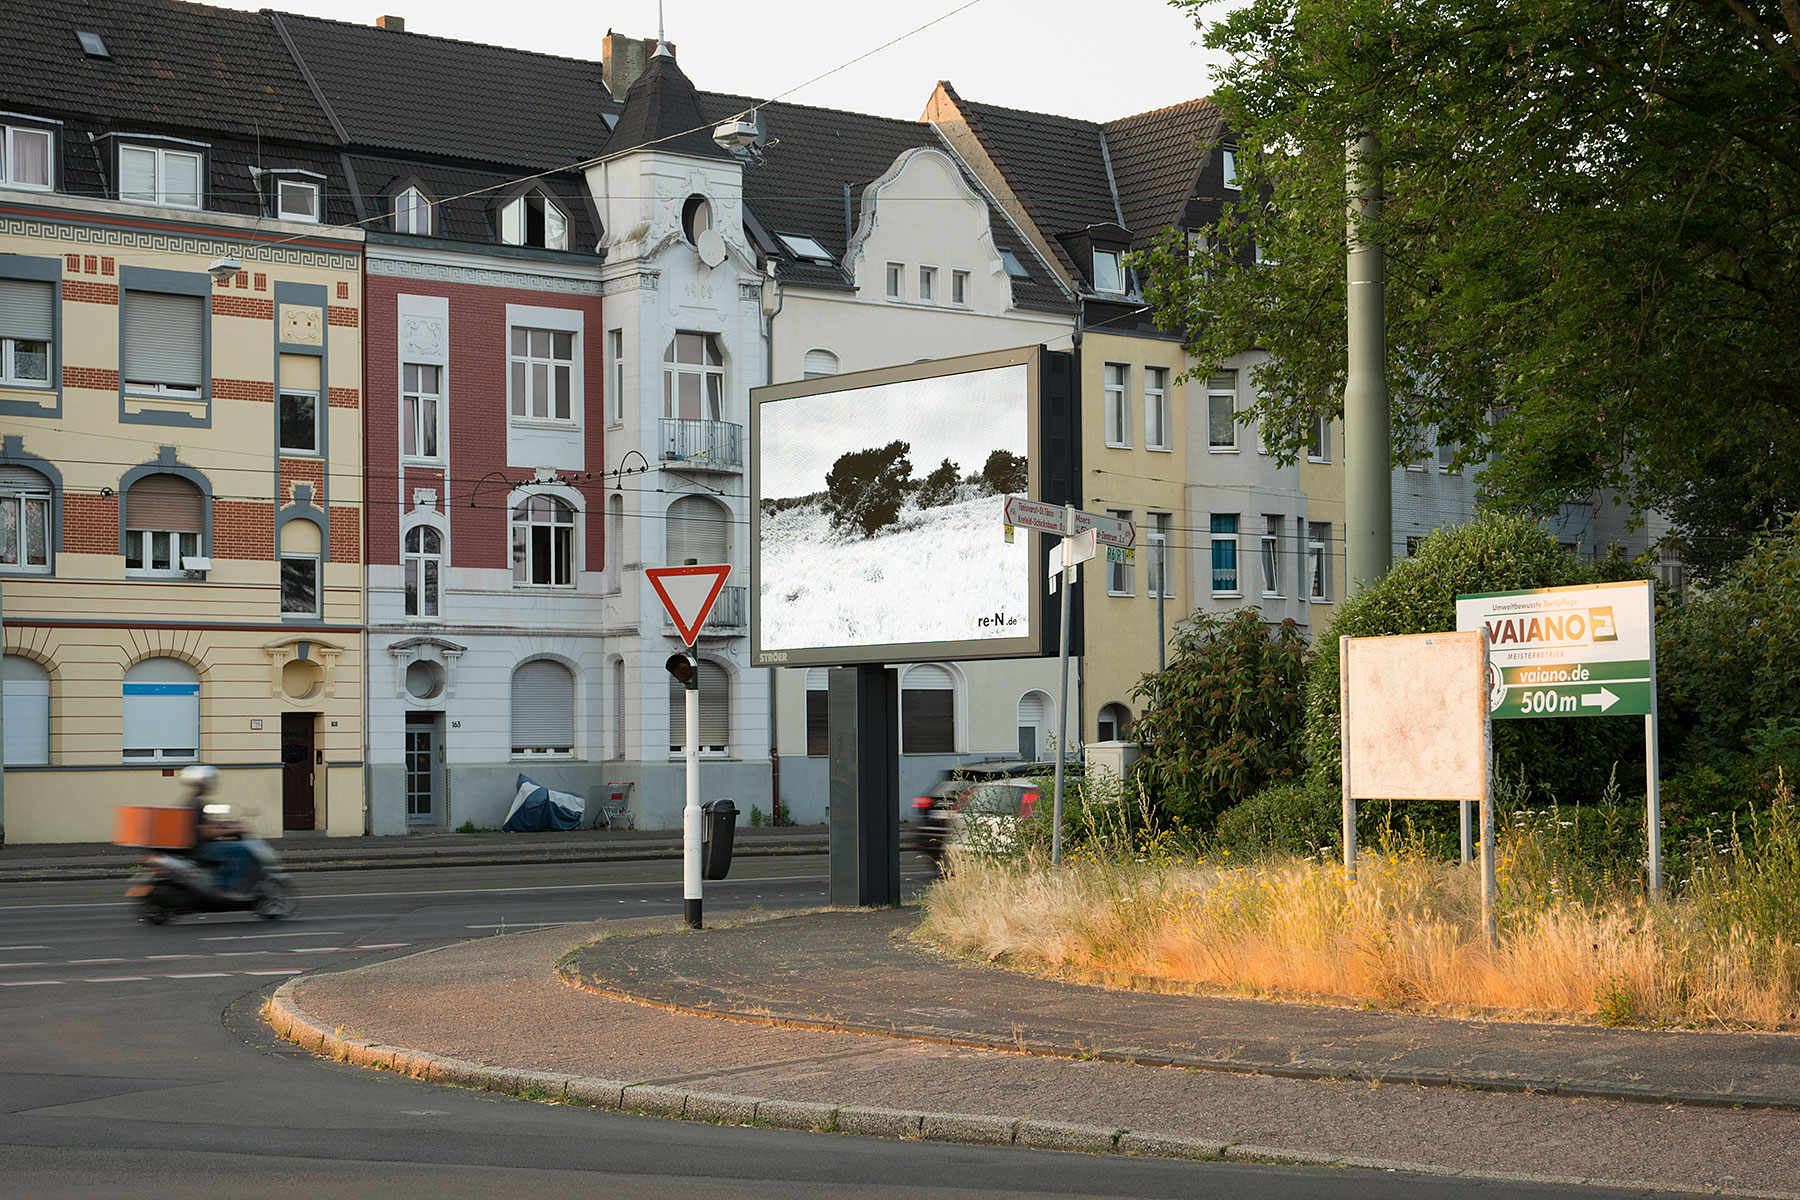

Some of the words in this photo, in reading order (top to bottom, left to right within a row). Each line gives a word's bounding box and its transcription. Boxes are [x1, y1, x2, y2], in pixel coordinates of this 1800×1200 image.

[1075, 514, 1091, 525] Moers
[1107, 547, 1115, 561] R6
[1116, 549, 1125, 562] R1
[1492, 602, 1542, 611] Umweltbewusste
[1485, 614, 1586, 645] VAIANO
[759, 652, 788, 663] STRÖER
[1507, 650, 1565, 660] MEISTERBETRIEB
[1519, 664, 1590, 683] vaiano.de
[1520, 690, 1558, 714] 500
[1559, 695, 1577, 712] m
